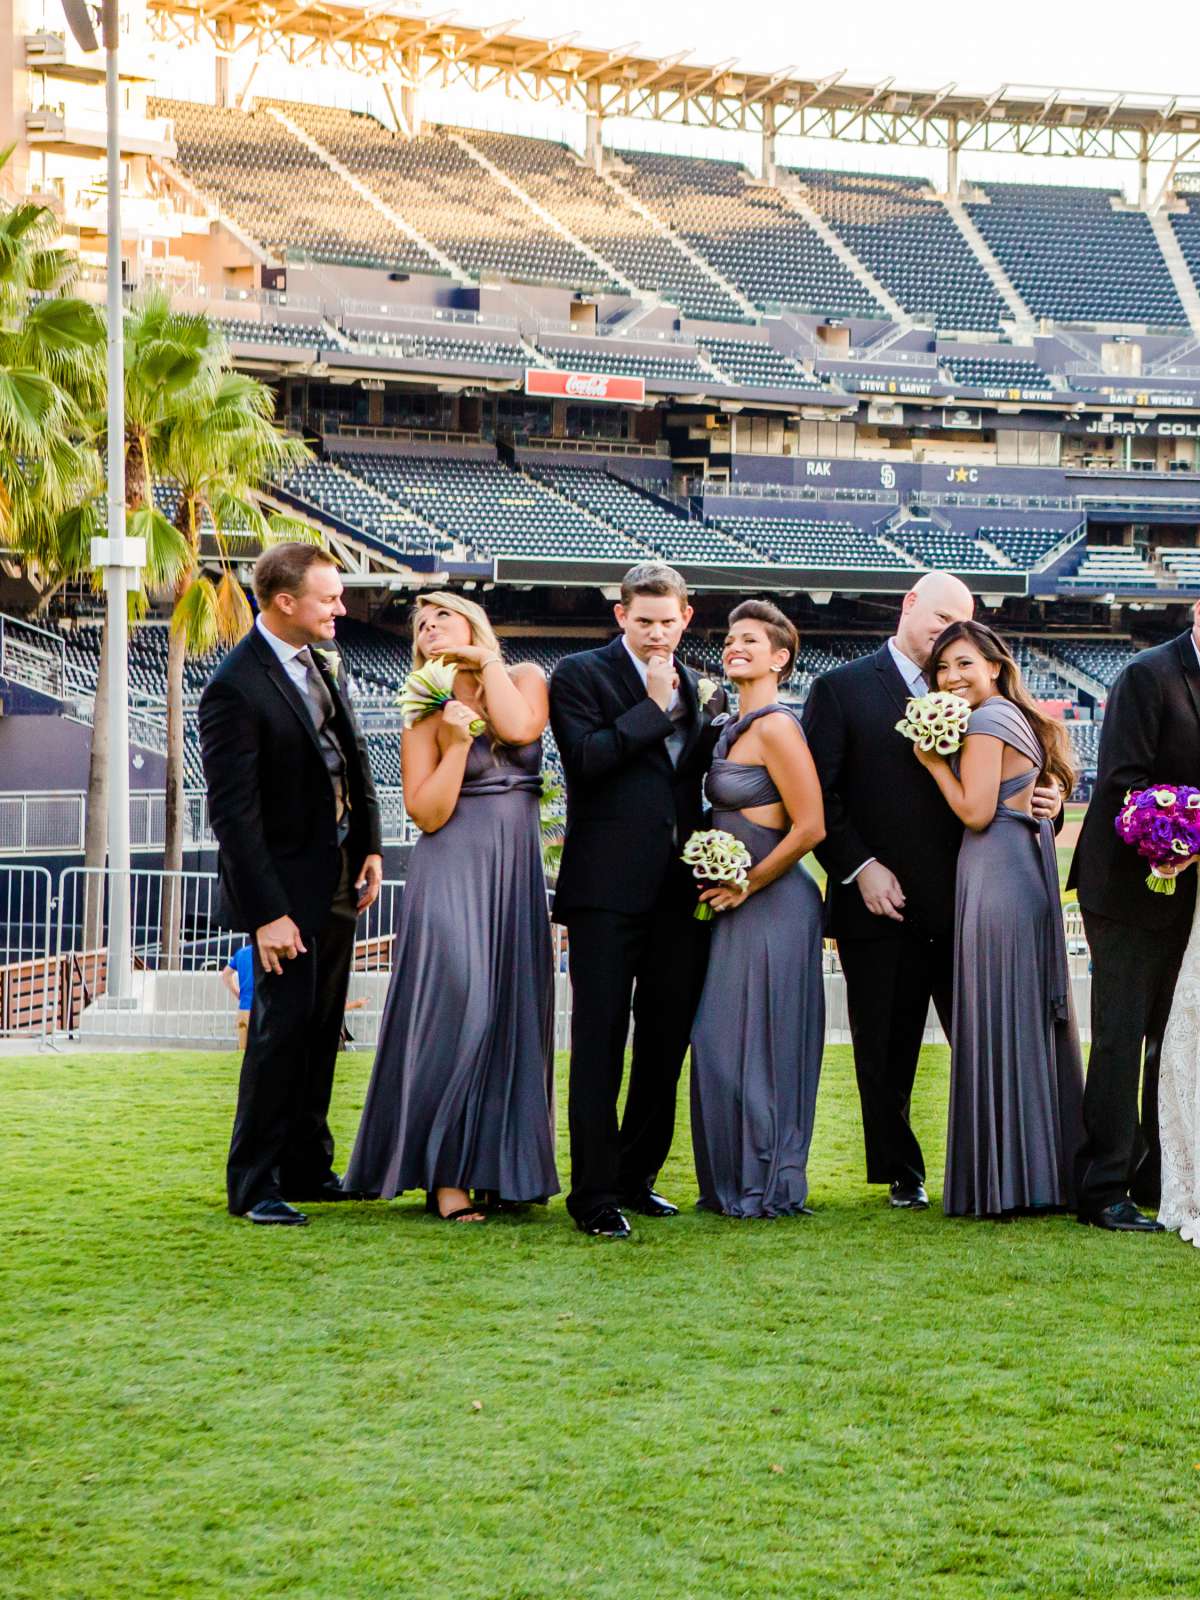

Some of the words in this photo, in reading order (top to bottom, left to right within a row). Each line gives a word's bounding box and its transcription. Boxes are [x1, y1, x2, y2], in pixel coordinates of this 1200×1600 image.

[860, 381, 886, 392] STEVE
[900, 383, 931, 394] GARVEY
[984, 388, 1006, 398] TONY
[1008, 389, 1021, 400] 19
[1110, 395, 1134, 405] DAVE
[1086, 421, 1149, 435] JERRY
[806, 461, 832, 476] RAK
